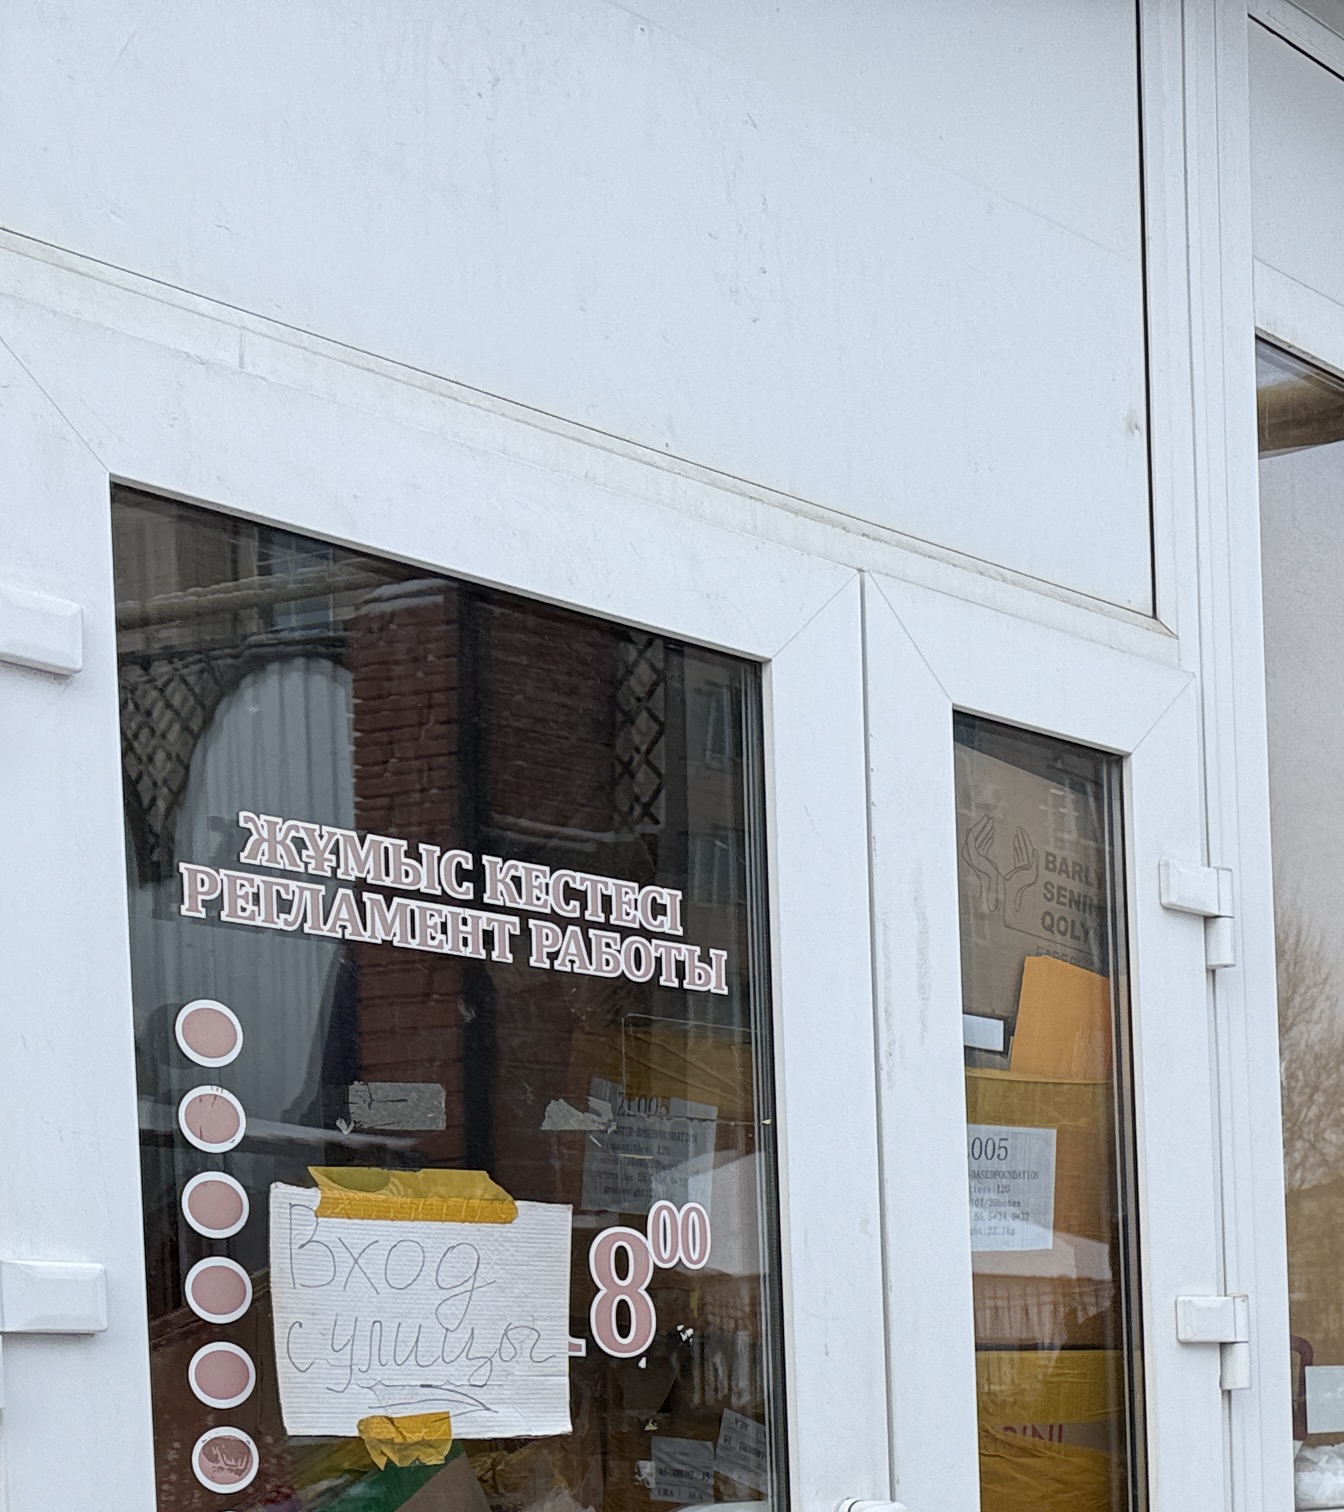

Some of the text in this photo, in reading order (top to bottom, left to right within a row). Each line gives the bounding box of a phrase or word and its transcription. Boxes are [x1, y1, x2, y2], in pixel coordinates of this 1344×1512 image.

[179, 862, 729, 995] РЕГЛАМЕНТ РАБОТЫ
[238, 810, 684, 936] ЖҰМЫС КЕСТЕСІ
[289, 1202, 497, 1333] Вход
